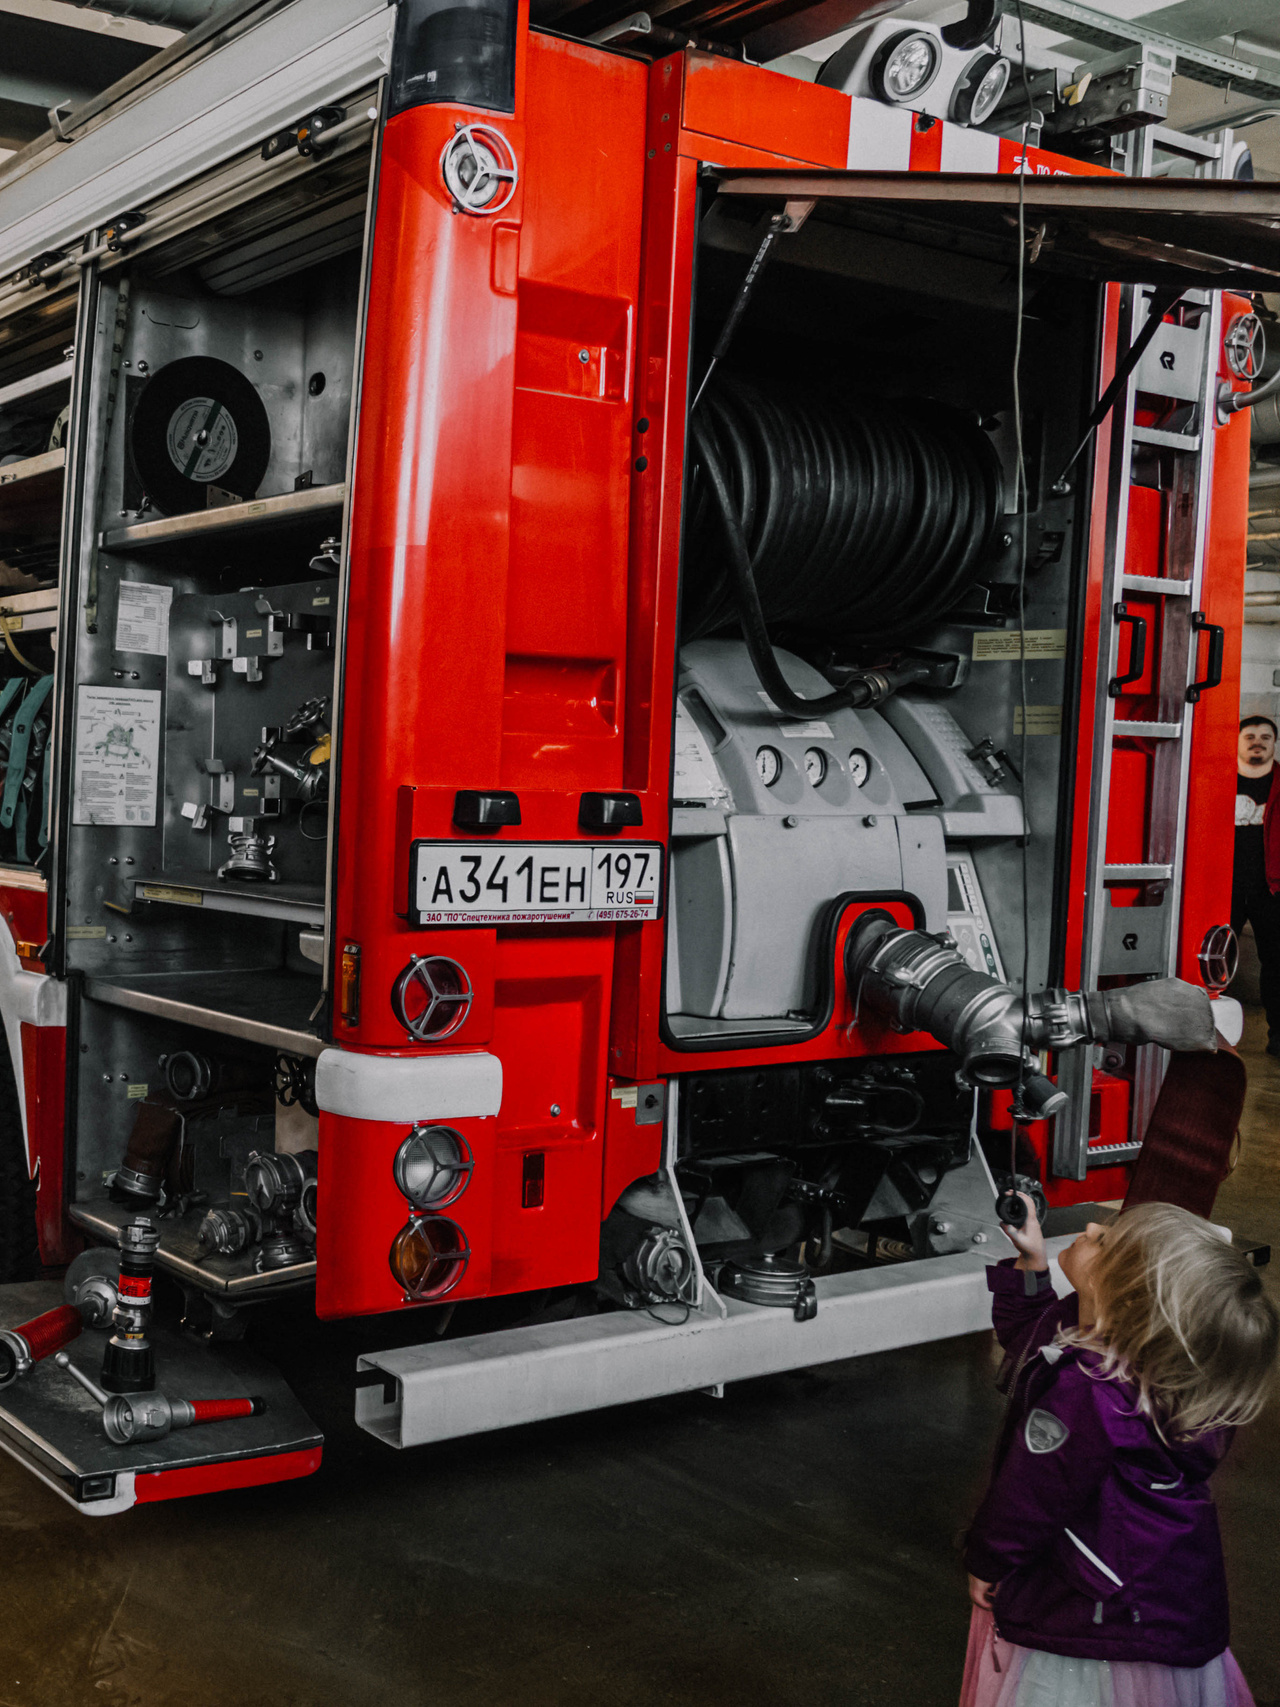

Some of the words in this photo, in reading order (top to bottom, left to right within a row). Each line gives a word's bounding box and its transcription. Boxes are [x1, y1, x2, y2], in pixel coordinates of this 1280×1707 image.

[597, 852, 650, 889] 197
[606, 891, 633, 904] RUS
[426, 913, 442, 922] ЗАО
[596, 910, 614, 920] (495)
[615, 909, 649, 919] 675-26-74
